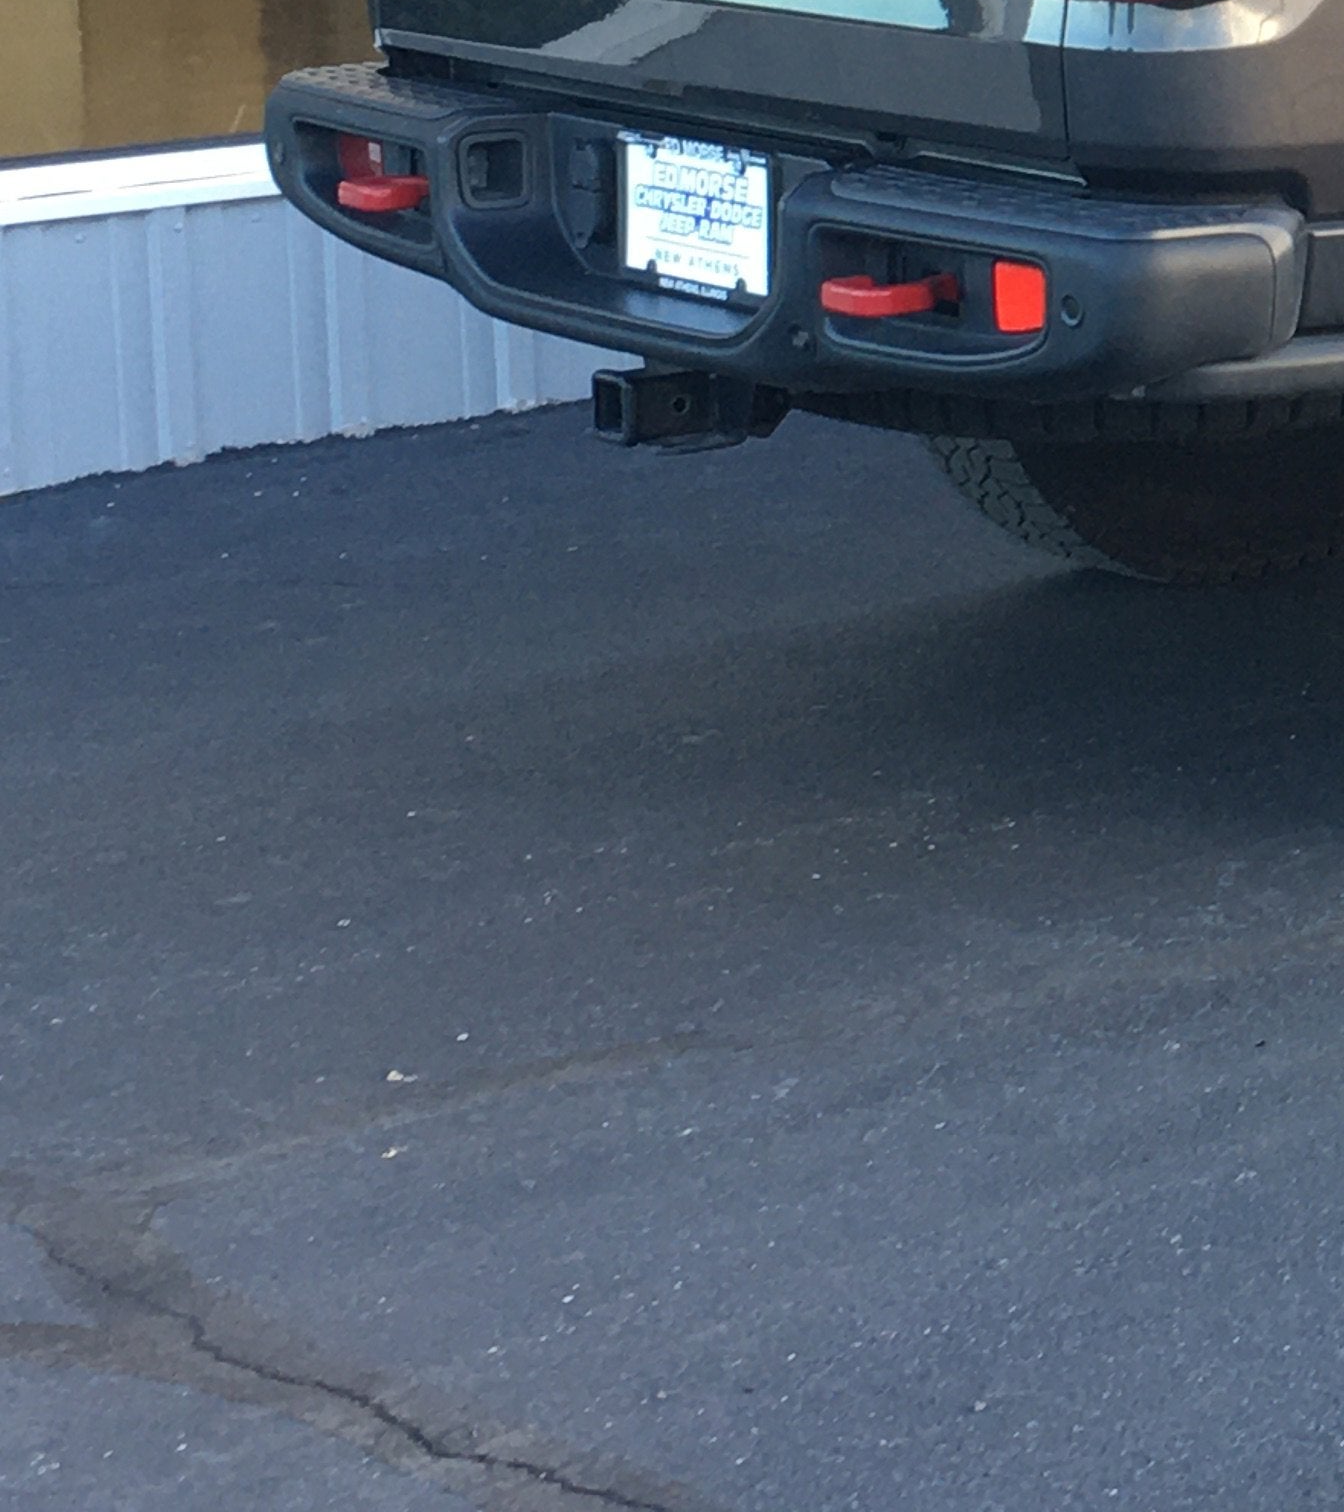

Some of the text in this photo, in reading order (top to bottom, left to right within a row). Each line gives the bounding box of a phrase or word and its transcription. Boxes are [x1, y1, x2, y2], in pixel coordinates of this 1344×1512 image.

[653, 159, 749, 205] ED MORSE
[635, 183, 707, 218] CHRYSLER
[698, 218, 734, 245] RAM
[655, 248, 739, 276] NEW ATHENS
